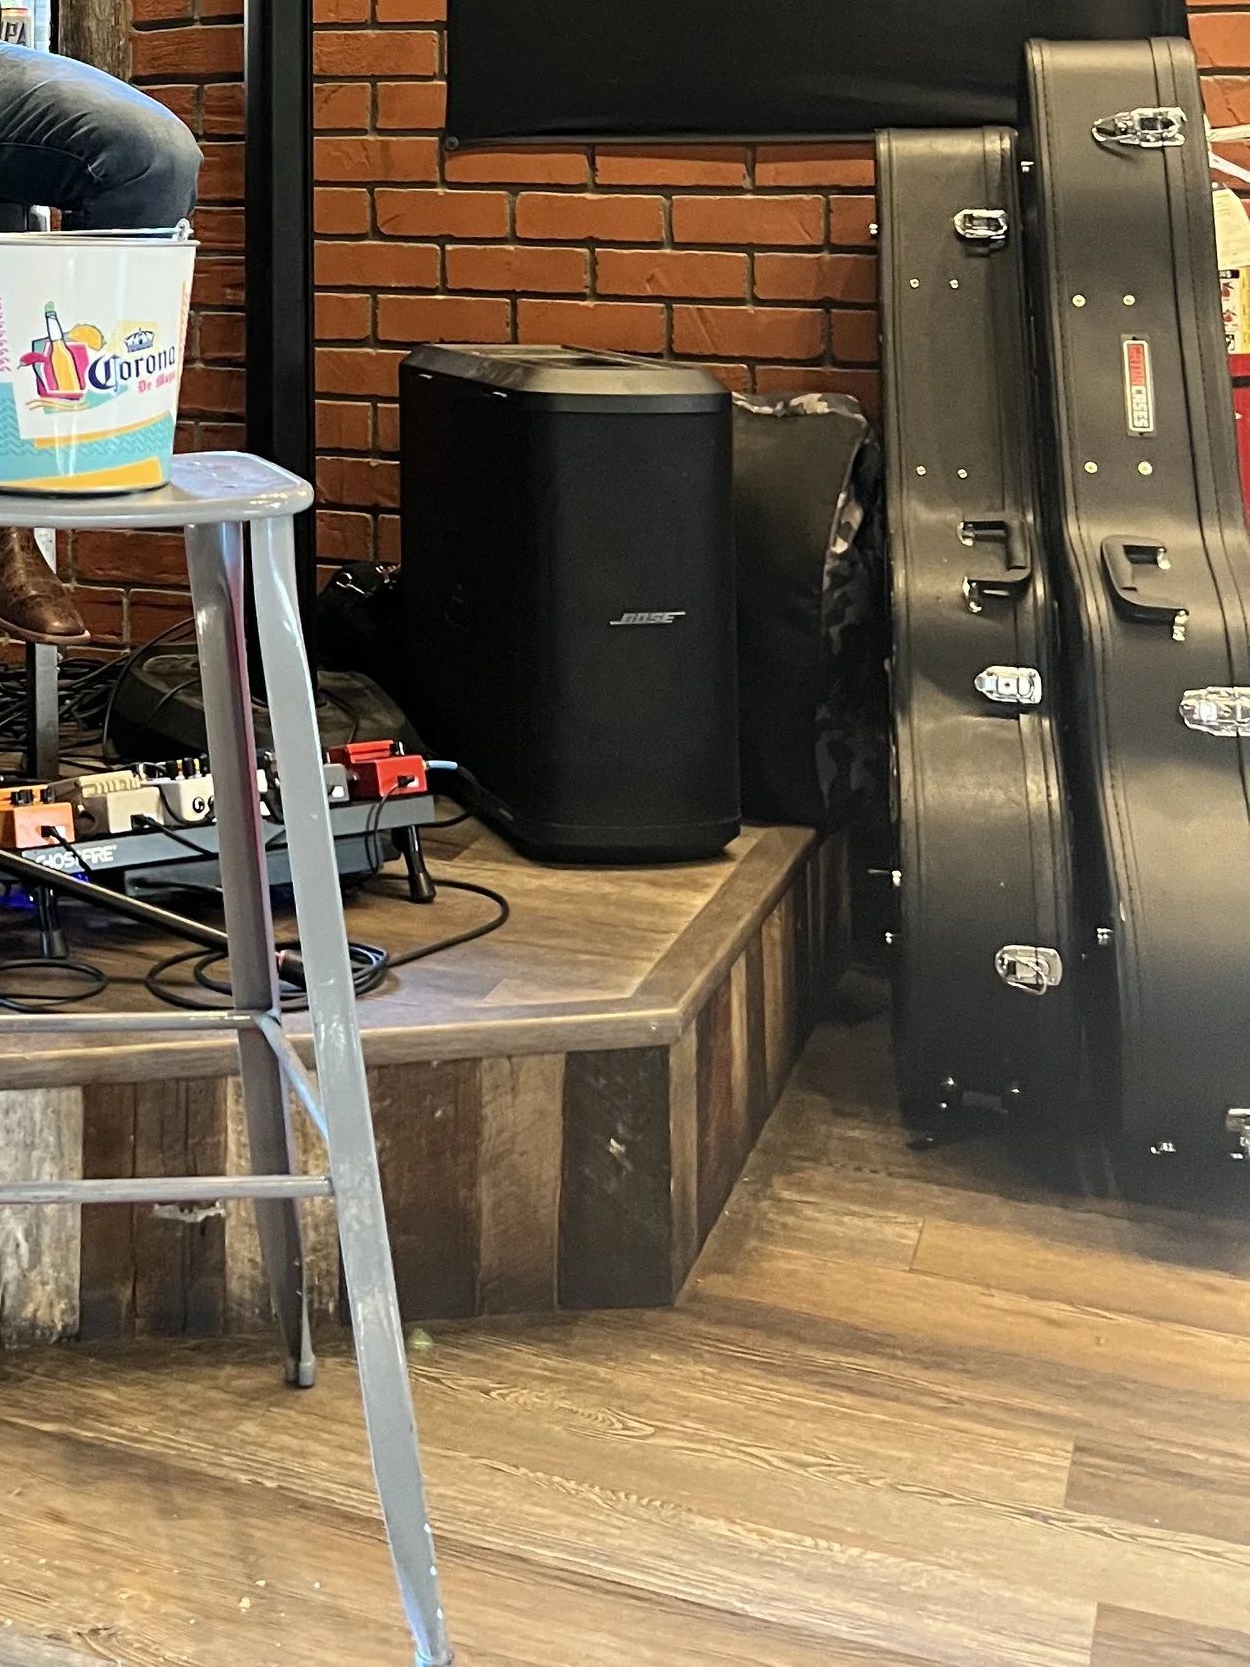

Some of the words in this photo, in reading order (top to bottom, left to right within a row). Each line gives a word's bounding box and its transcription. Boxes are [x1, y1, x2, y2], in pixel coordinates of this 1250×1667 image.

[88, 345, 176, 393] Corona
[609, 611, 686, 625] BOSE
[35, 846, 114, 869] GHOSFIRE
